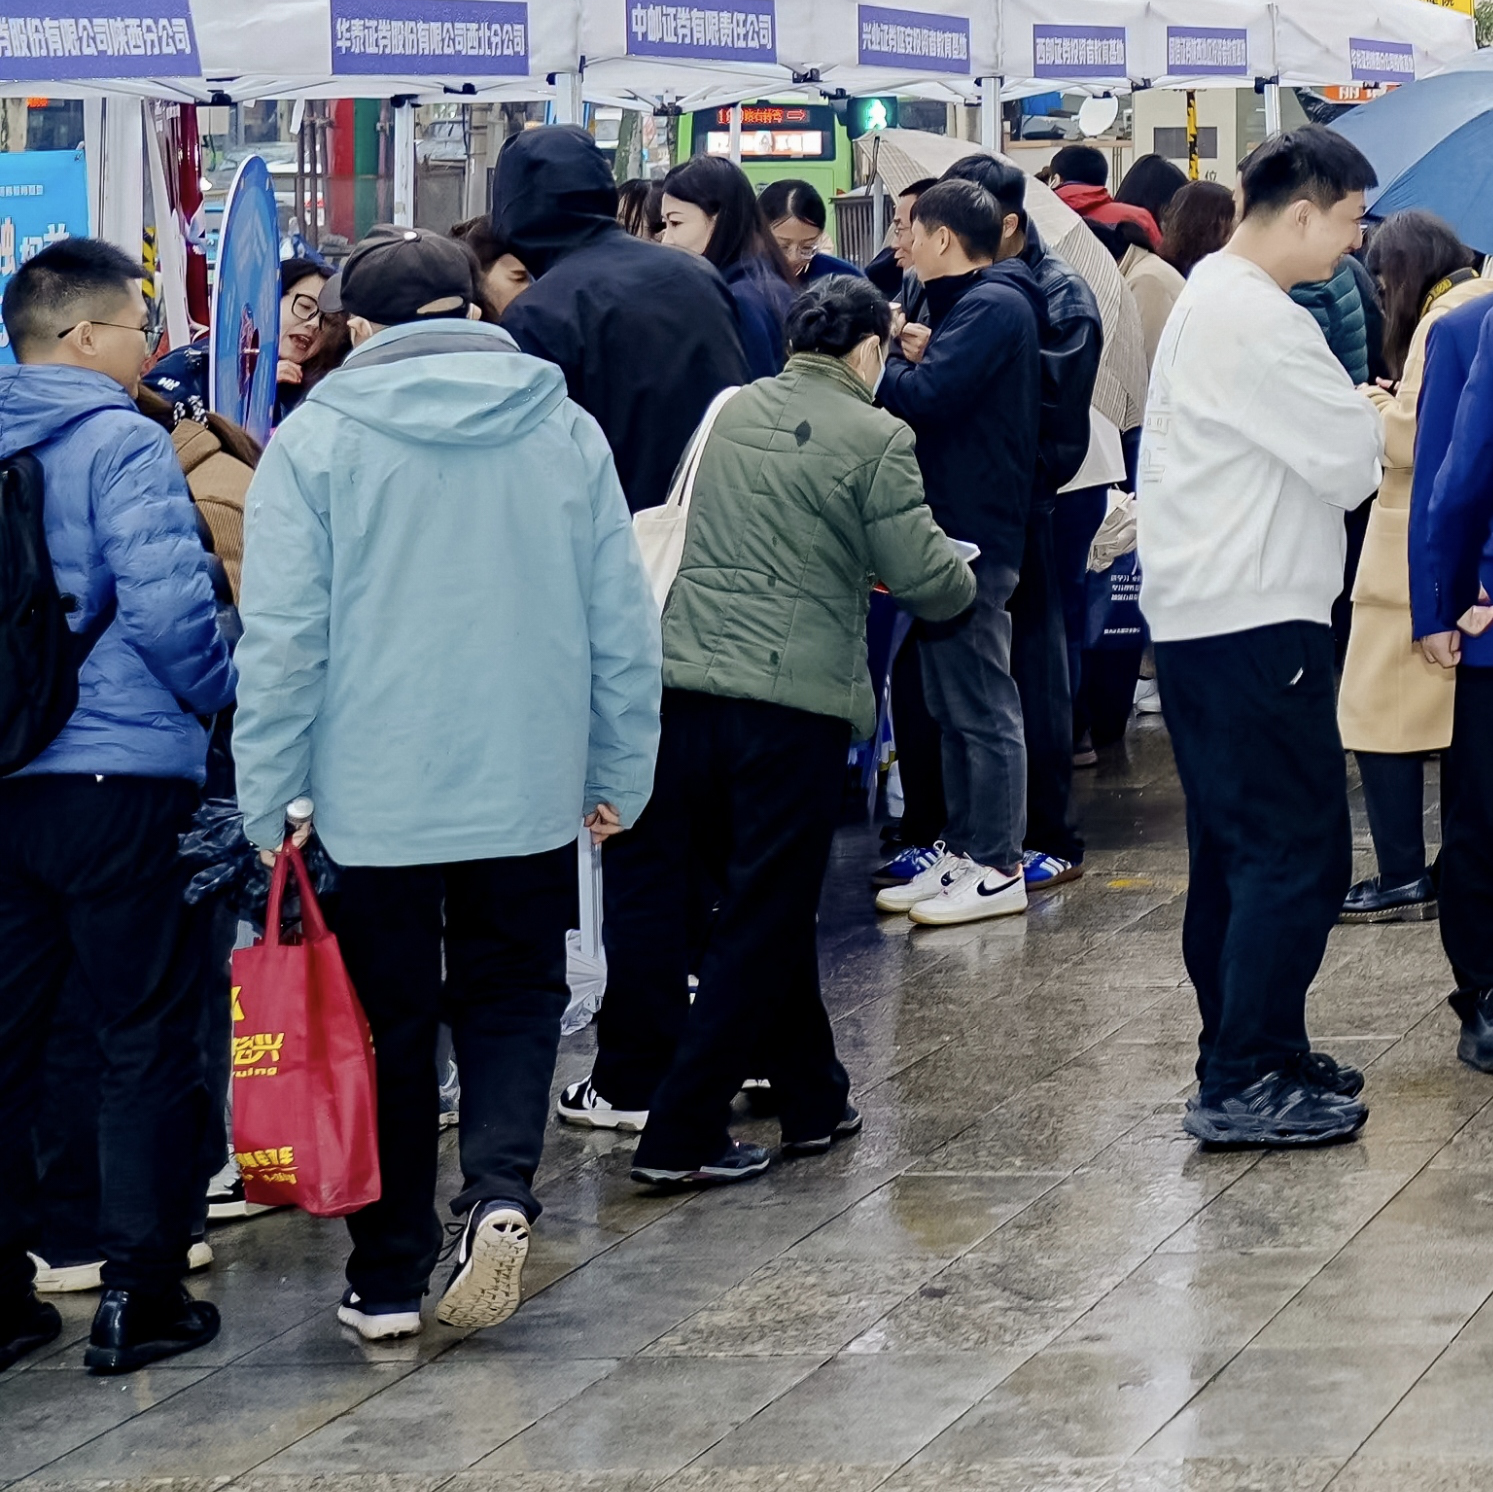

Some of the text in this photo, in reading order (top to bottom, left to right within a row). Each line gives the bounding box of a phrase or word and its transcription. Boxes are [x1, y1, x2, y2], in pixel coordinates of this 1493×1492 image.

[335, 17, 526, 57] 华泰证券股份有限公司西北分公司
[631, 3, 772, 49] 中邮证券有限责任公司
